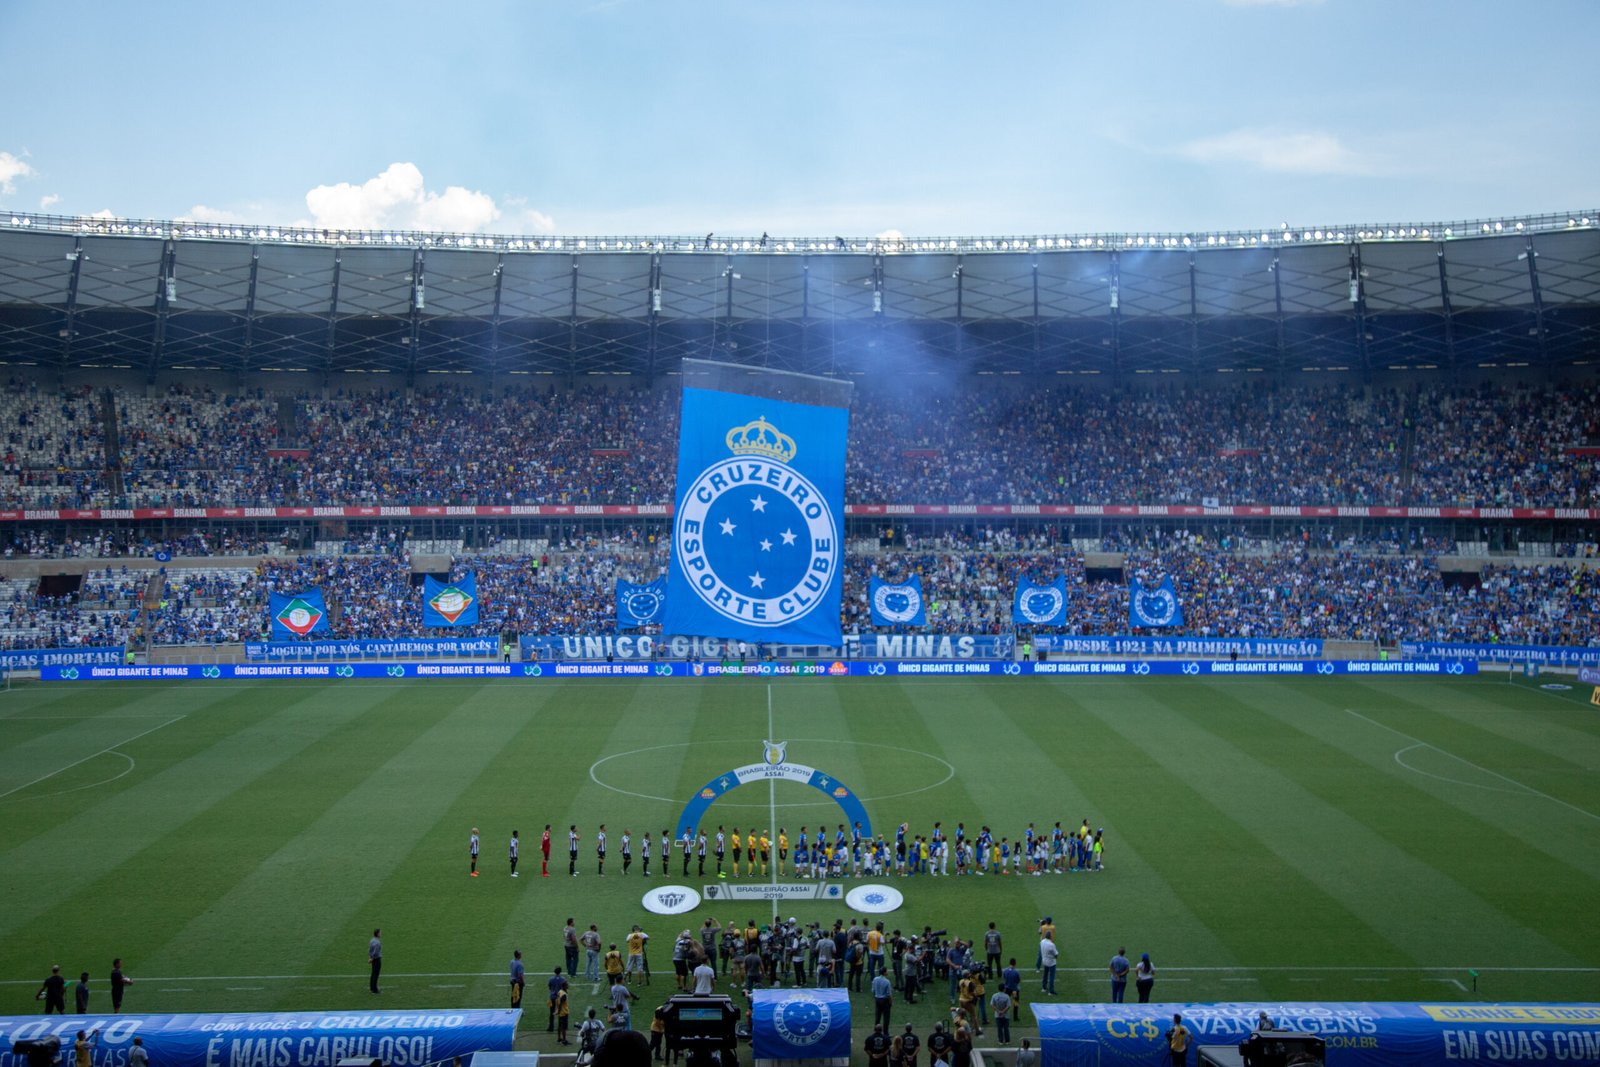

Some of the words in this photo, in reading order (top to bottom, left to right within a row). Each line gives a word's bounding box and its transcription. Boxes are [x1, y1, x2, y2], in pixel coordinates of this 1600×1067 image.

[696, 463, 822, 520] CRUZEIRO
[100, 509, 134, 519] BRAHMA
[173, 508, 207, 518] BRAHMA
[244, 507, 277, 517] BRAHMA
[313, 507, 344, 516] BRAHMA
[380, 507, 411, 516] BRAHMA
[446, 506, 476, 515] BRAHMA
[511, 505, 540, 515] BRAHMA
[574, 505, 603, 514] BRAHMA
[637, 505, 667, 514] BRAHMA
[886, 505, 915, 514] BRAHMA
[948, 505, 977, 514] BRAHMA
[1011, 505, 1040, 514] BRAHMA
[1074, 505, 1104, 514] BRAHMA
[1138, 506, 1168, 515] BRAHMA
[1270, 506, 1301, 516] BRAHMA
[1338, 507, 1369, 516] BRAHMA
[1407, 507, 1440, 517] BRAHMA
[1479, 508, 1513, 518] BRAHMA
[1554, 509, 1589, 518] BRAHMA
[24, 510, 60, 520] BRAHMA
[683, 519, 767, 620] ESPORTE
[778, 537, 831, 616] CLUBE
[269, 647, 312, 656] JOGUEM
[317, 646, 337, 655] POR
[366, 642, 434, 654] CANTAREMOS
[437, 642, 457, 652] POR
[460, 640, 491, 651] VOCÊS
[877, 635, 975, 658] MINAS
[1063, 639, 1112, 652] DESDE
[1115, 640, 1146, 653] 1921
[1153, 640, 1172, 653] NA
[1176, 641, 1252, 654] PRIMEIRA
[1256, 641, 1318, 655] DIVISÃO
[43, 651, 119, 667] IMORTAIS
[1429, 647, 1475, 657] AMAMOS
[1479, 648, 1487, 657] O
[1489, 648, 1546, 660] CRUZEIRO
[1549, 651, 1558, 661] E
[1571, 652, 1579, 661] O
[234, 665, 258, 675] ÚNICO
[259, 667, 292, 675] GIGANTE
[293, 666, 304, 675] DE
[305, 666, 329, 675] MINAS
[417, 664, 441, 674] ÚNICO
[441, 666, 474, 674] GIGANTE
[474, 665, 486, 674] DE
[487, 665, 511, 674] MINAS
[555, 664, 578, 674] ÚNICO
[579, 665, 611, 674] GIGANTE
[612, 665, 623, 673] DE
[624, 665, 649, 673] MINAS
[708, 664, 771, 673] BRASILEIRÃO
[804, 665, 825, 673] 2019
[898, 663, 920, 673] ÚNICO
[922, 664, 953, 673] GIGANTE
[954, 664, 965, 672] DE
[965, 664, 990, 672] MINAS
[1034, 662, 1057, 672] ÚNICO
[1058, 664, 1089, 672] GIGANTE
[1090, 663, 1101, 672] DE
[1101, 663, 1126, 672] MINAS
[1211, 661, 1234, 672] ÚNICO
[1235, 663, 1267, 672] GIGANTE
[1267, 663, 1278, 671] DE
[1279, 663, 1304, 671] MINAS
[1347, 661, 1370, 672] ÚNICO
[1371, 662, 1402, 672] GIGANTE
[1404, 662, 1414, 672] DE
[1415, 662, 1440, 672] MINAS
[92, 667, 116, 677] ÚNICO
[117, 668, 150, 676] GIGANTE
[151, 668, 163, 676] DE
[164, 668, 188, 676] MINAS
[737, 765, 791, 778] BRASILEIRÃO
[791, 767, 811, 777] 2019
[1523, 1008, 1545, 1020] E
[247, 1019, 297, 1031] VOCÊ
[319, 1015, 465, 1029] CRUZEIRO
[1188, 1016, 1378, 1034] VANAGENS
[1106, 1016, 1160, 1042] Cr$
[206, 1033, 225, 1067] É
[230, 1037, 292, 1067] MAIS
[1443, 1030, 1480, 1060] EM
[1484, 1030, 1548, 1060] SUAS
